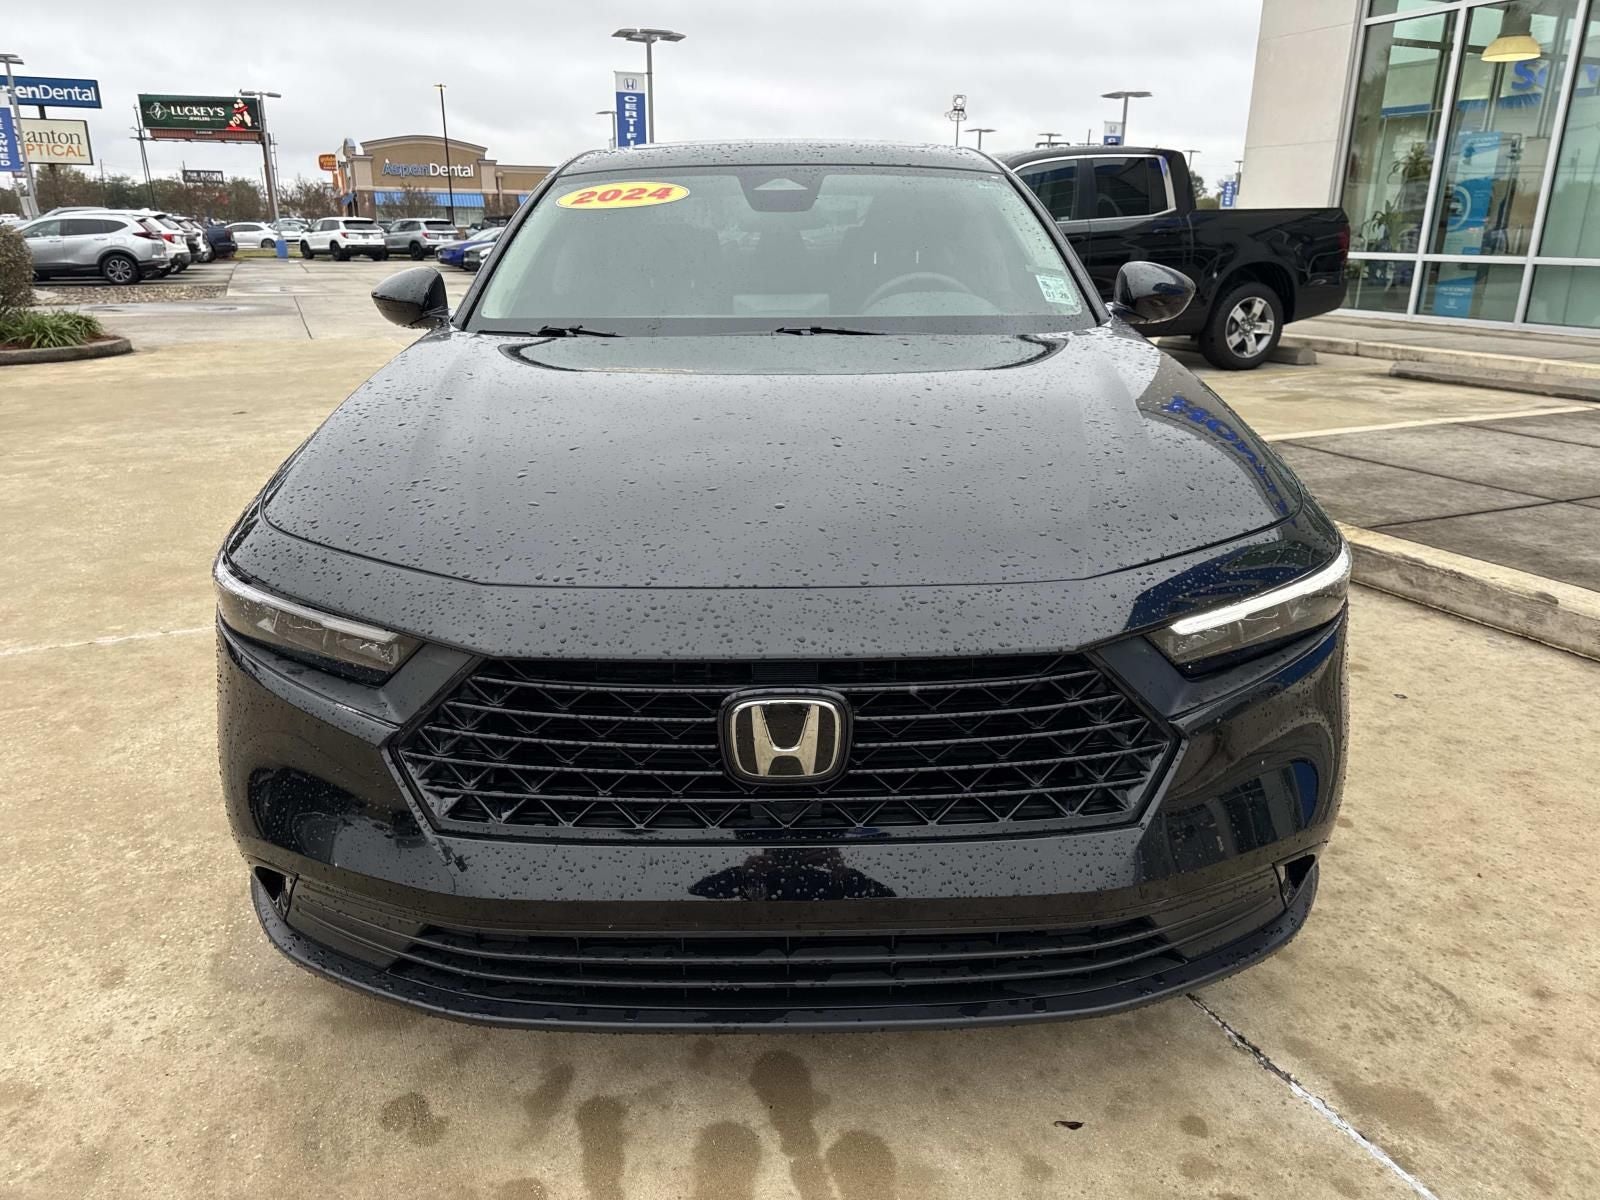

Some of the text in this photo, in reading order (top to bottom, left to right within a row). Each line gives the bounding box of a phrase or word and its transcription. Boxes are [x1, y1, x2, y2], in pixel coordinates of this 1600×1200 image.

[170, 105, 225, 117] LUCKEY'S
[23, 128, 82, 144] anton
[26, 143, 86, 157] PTICAL
[571, 187, 674, 205] 2024
